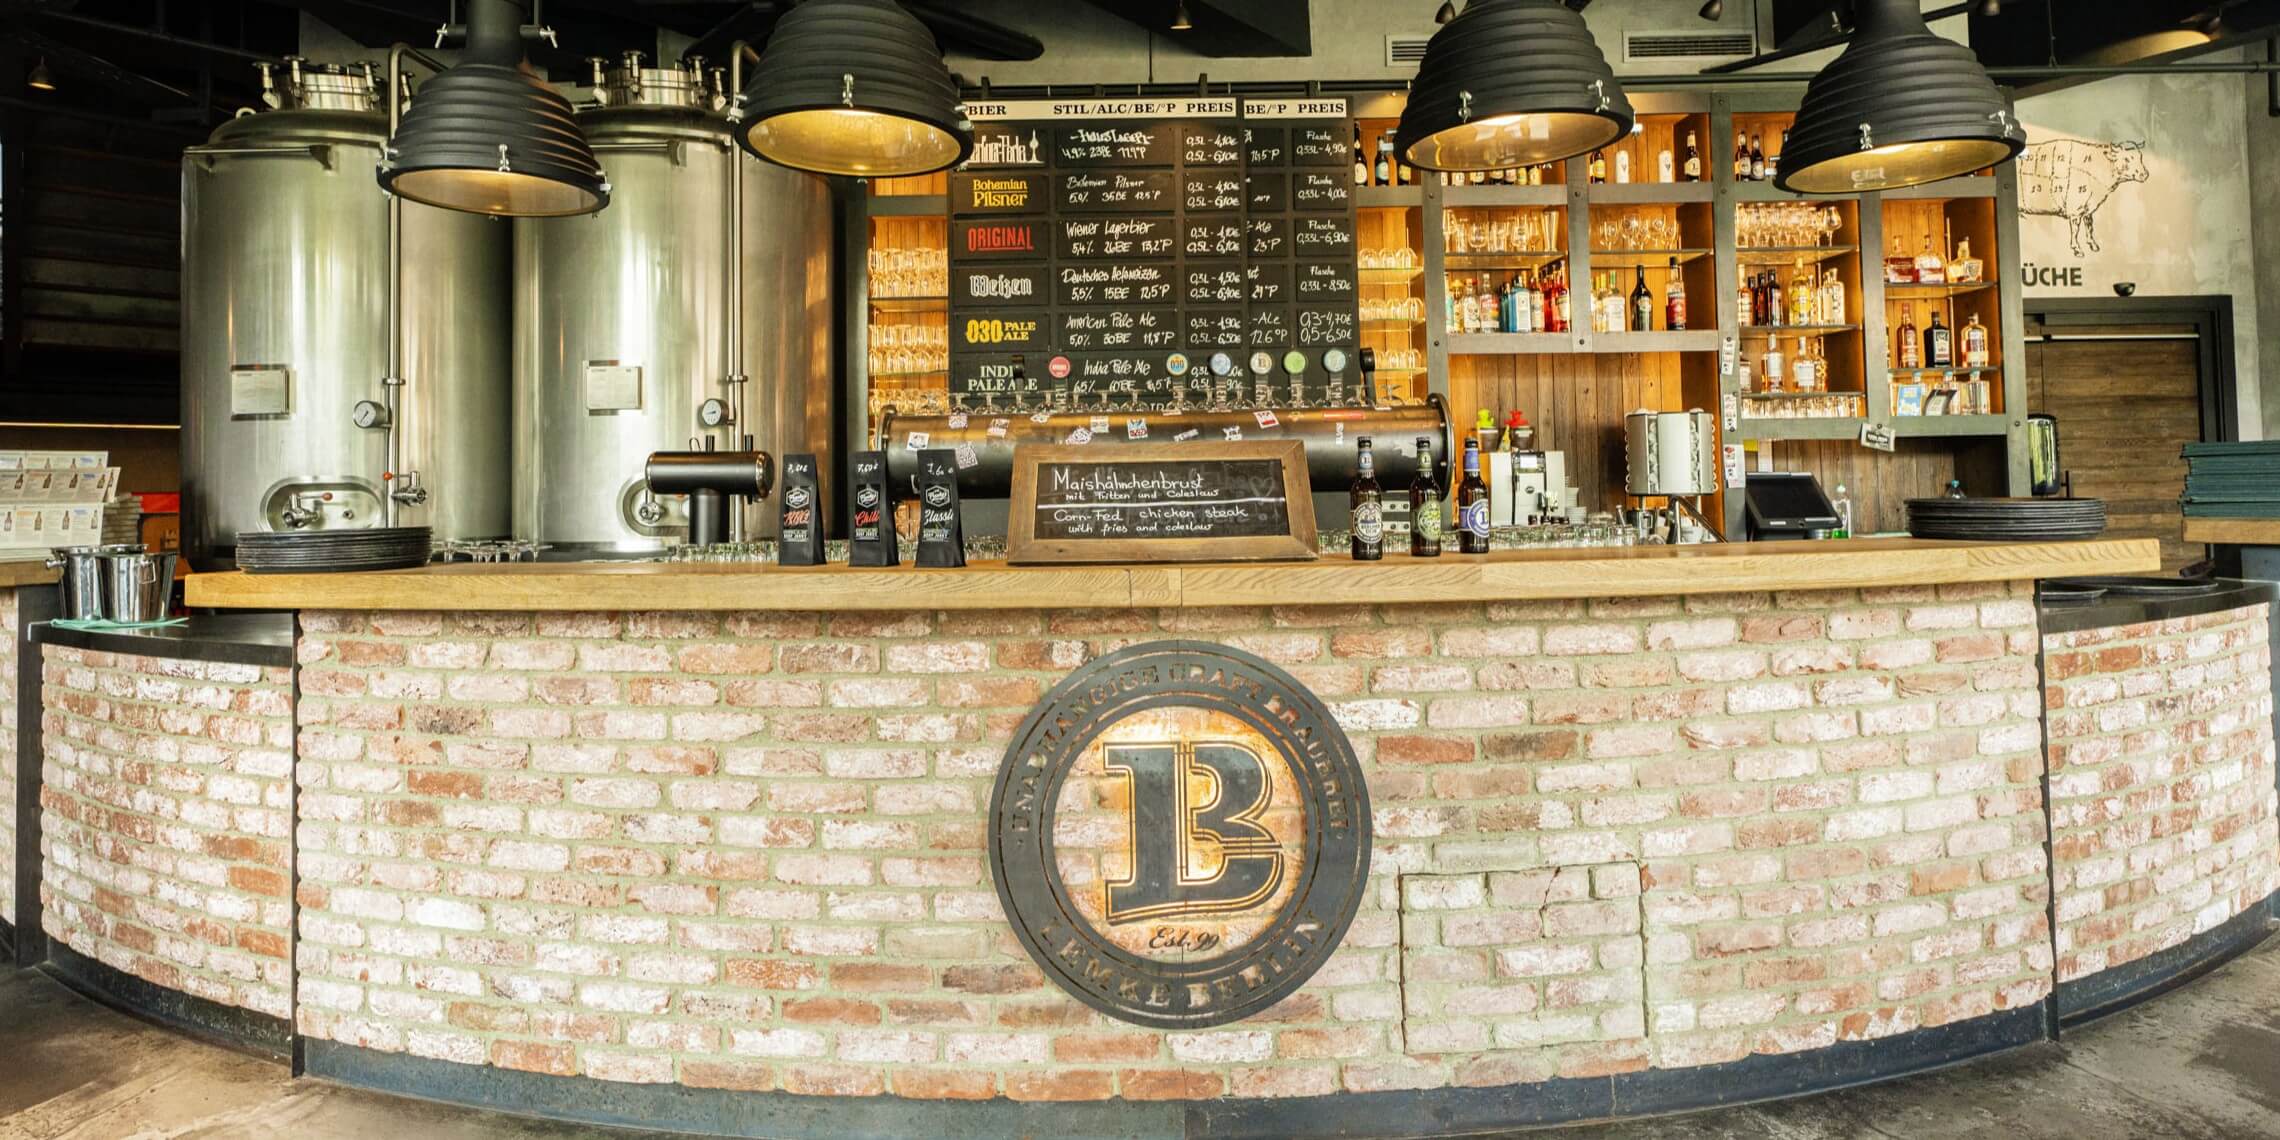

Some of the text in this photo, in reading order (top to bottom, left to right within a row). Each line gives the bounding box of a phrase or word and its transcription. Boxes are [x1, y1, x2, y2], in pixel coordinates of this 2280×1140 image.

[969, 105, 1007, 116] BIER
[1054, 103, 1176, 115] STIL/ALC/BE/°P
[1187, 102, 1234, 113] PREIS
[1246, 104, 1287, 115] BE/°P
[1298, 104, 1345, 114] PREIS
[973, 179, 1028, 190] Bohemian
[973, 191, 1028, 208] Pilsner
[1066, 218, 1156, 241] Wiener Lagerbier
[1308, 220, 1336, 230] Flasche
[968, 225, 1034, 252] ORIGINAL
[1061, 268, 1110, 284] Deutsches
[1310, 265, 1336, 276] Flasche
[2021, 263, 2083, 287] ÜCHE
[969, 274, 1032, 299] Weizen
[1110, 312, 1135, 328] Pale
[966, 319, 1036, 343] 030 PALE
[1004, 332, 1030, 341] ALE
[980, 365, 1018, 378] INDI
[1084, 360, 1109, 376] India
[967, 378, 1005, 391] PALE
[1066, 491, 1086, 500] mit
[1137, 490, 1158, 499] und
[1166, 489, 1220, 498] Coleslaw
[1139, 507, 1196, 519] chicken
[1204, 505, 1249, 519] steak
[1068, 520, 1215, 537] with fries and coleslaw
